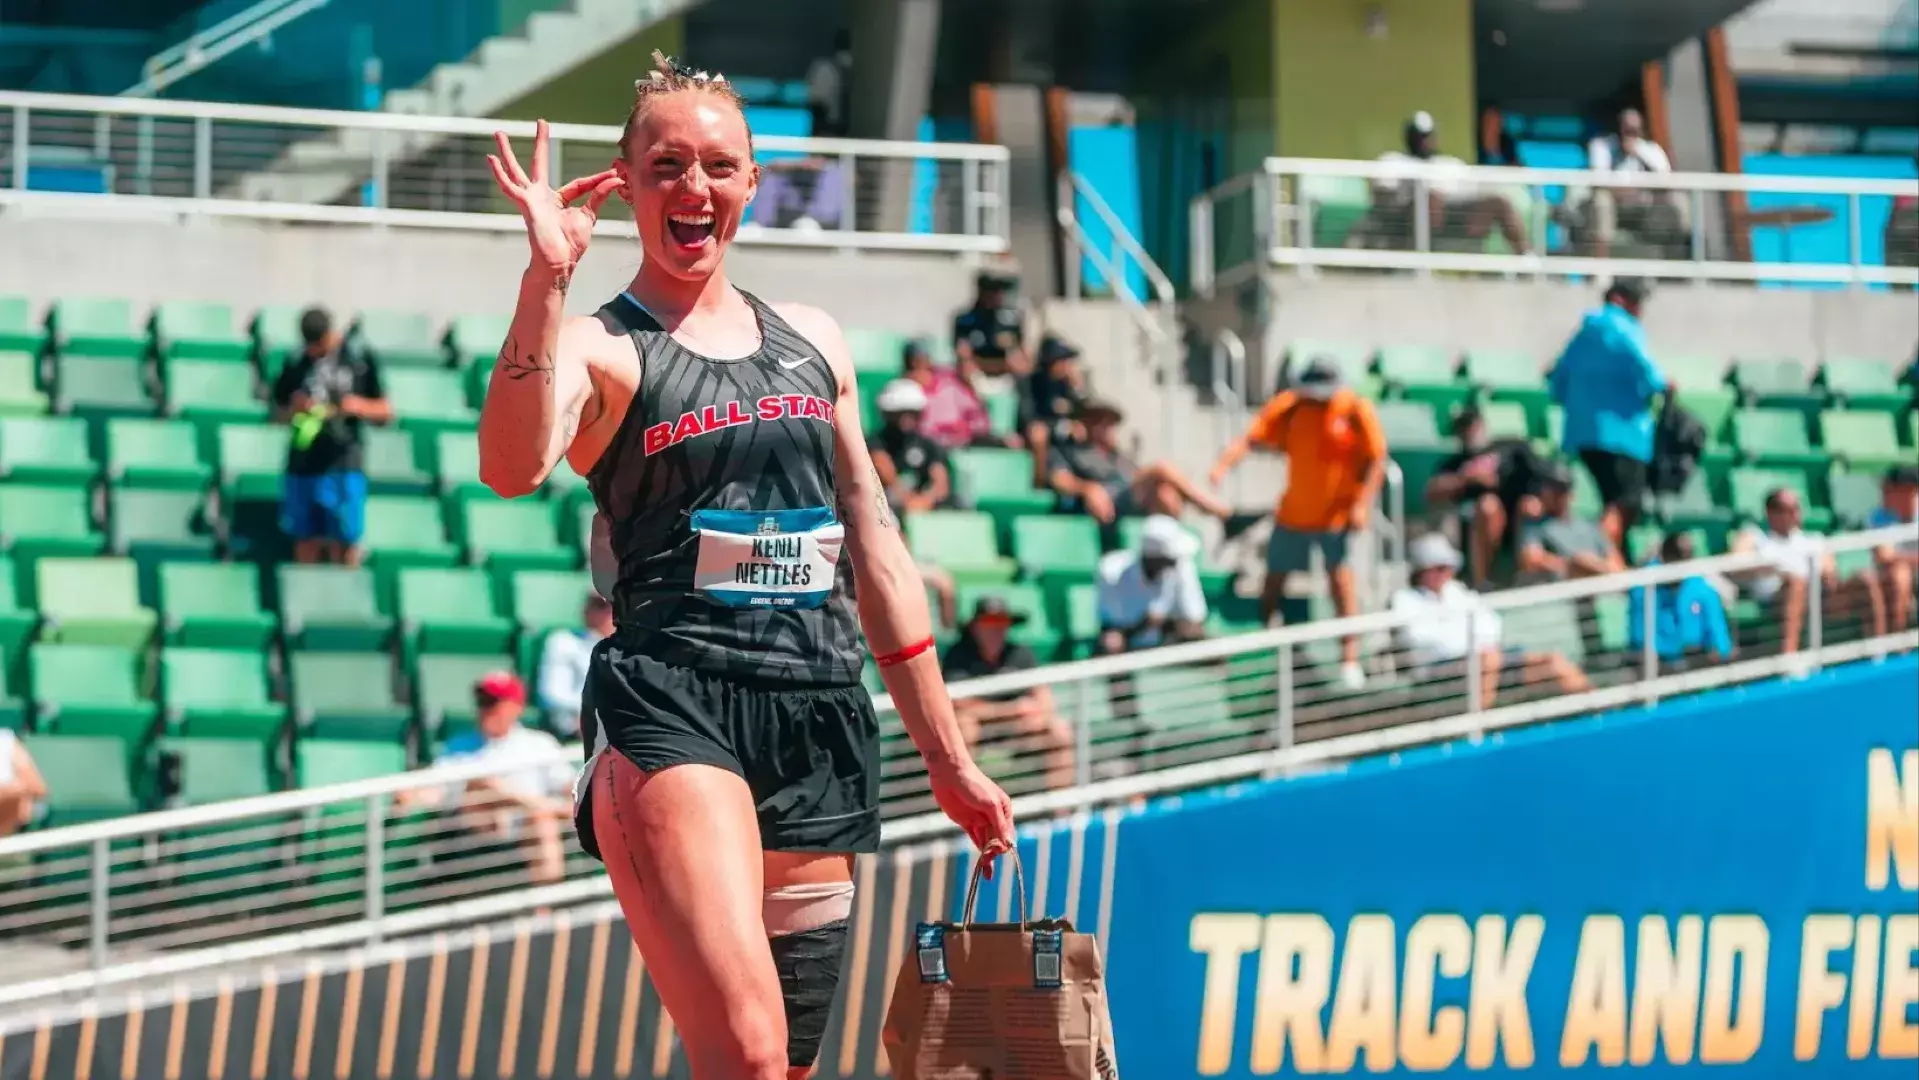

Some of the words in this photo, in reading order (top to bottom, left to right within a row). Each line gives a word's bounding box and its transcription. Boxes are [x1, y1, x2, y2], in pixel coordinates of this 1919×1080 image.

[644, 400, 752, 457] BALL
[757, 393, 836, 430] STAT
[751, 537, 802, 558] KENLI
[735, 562, 812, 586] NETTLES
[1189, 912, 1547, 1077] TRACK
[1559, 913, 1771, 1068] AND
